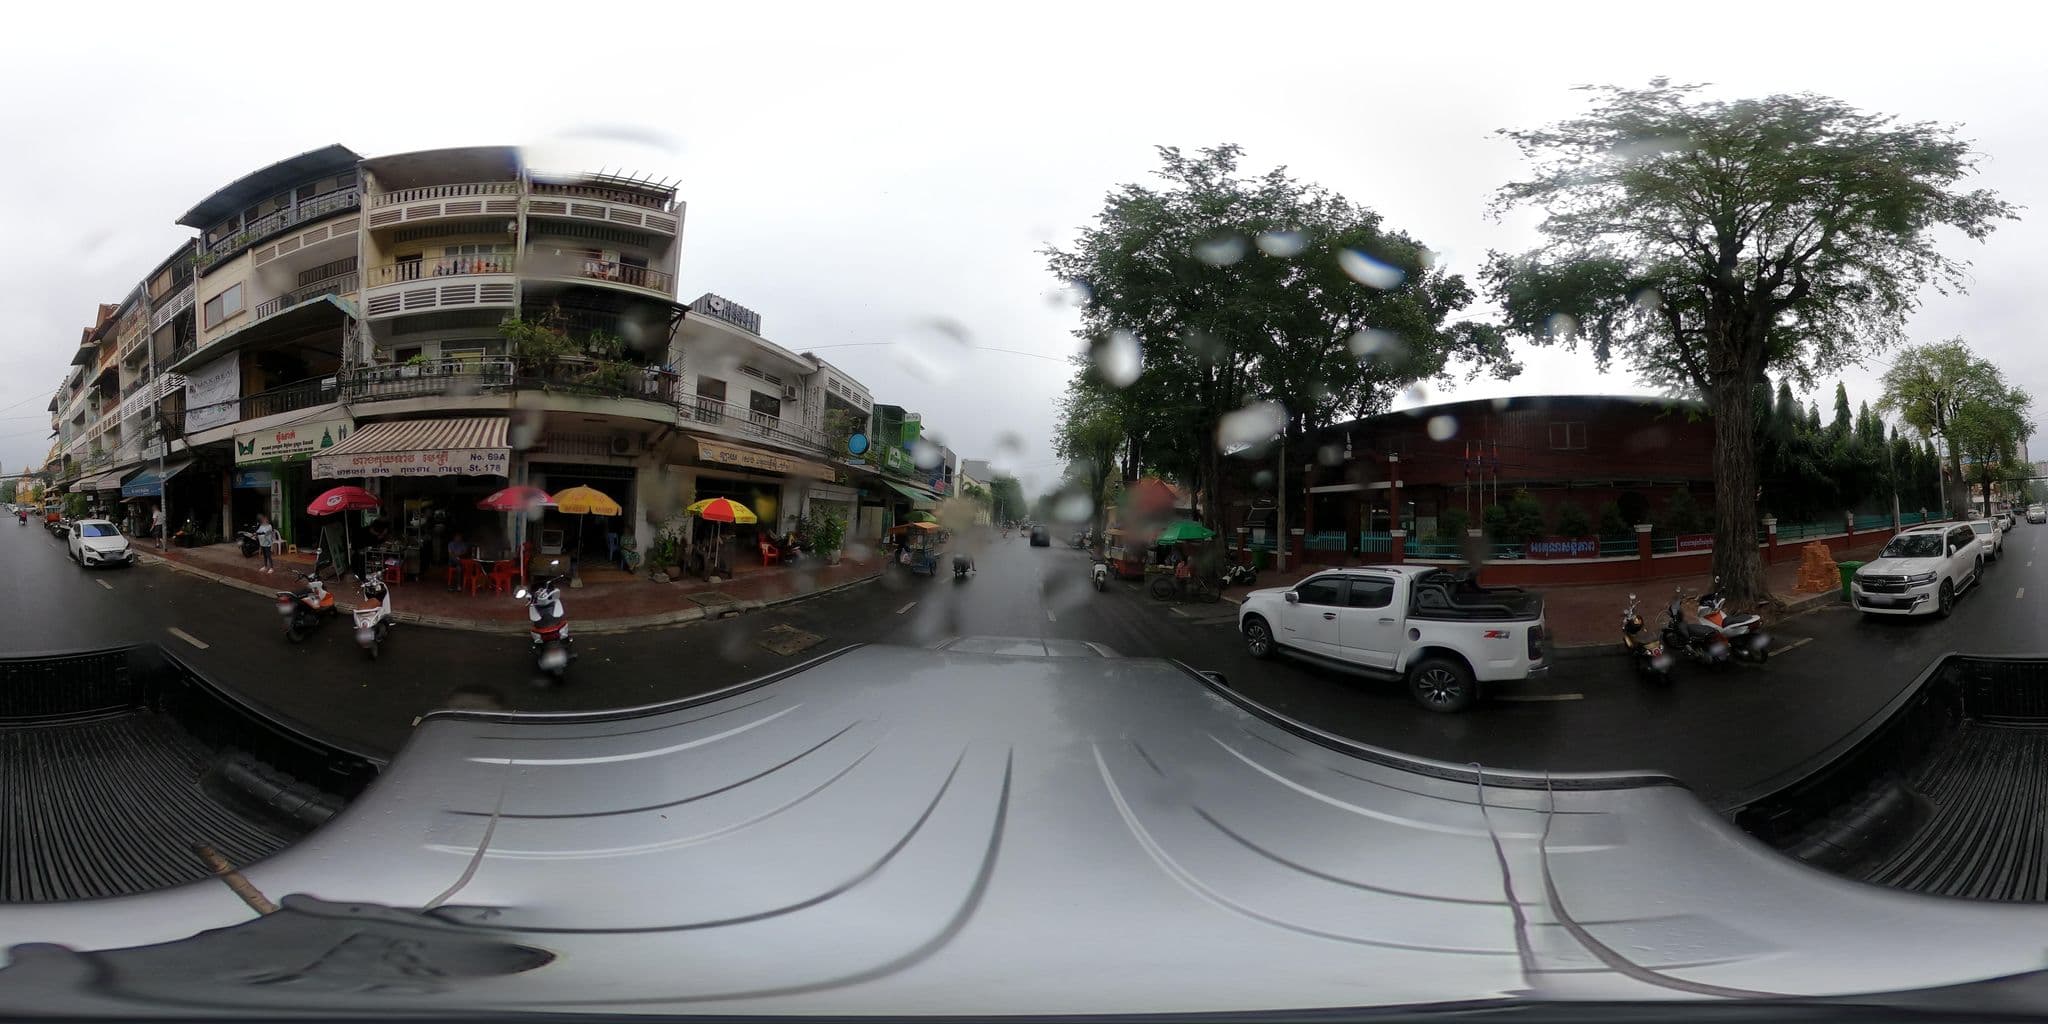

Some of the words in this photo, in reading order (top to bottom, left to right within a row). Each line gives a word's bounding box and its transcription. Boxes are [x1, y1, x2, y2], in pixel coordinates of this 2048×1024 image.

[470, 453, 484, 461] No.
[487, 453, 506, 461] 69A
[469, 464, 481, 472] St.
[484, 464, 501, 472] 178
